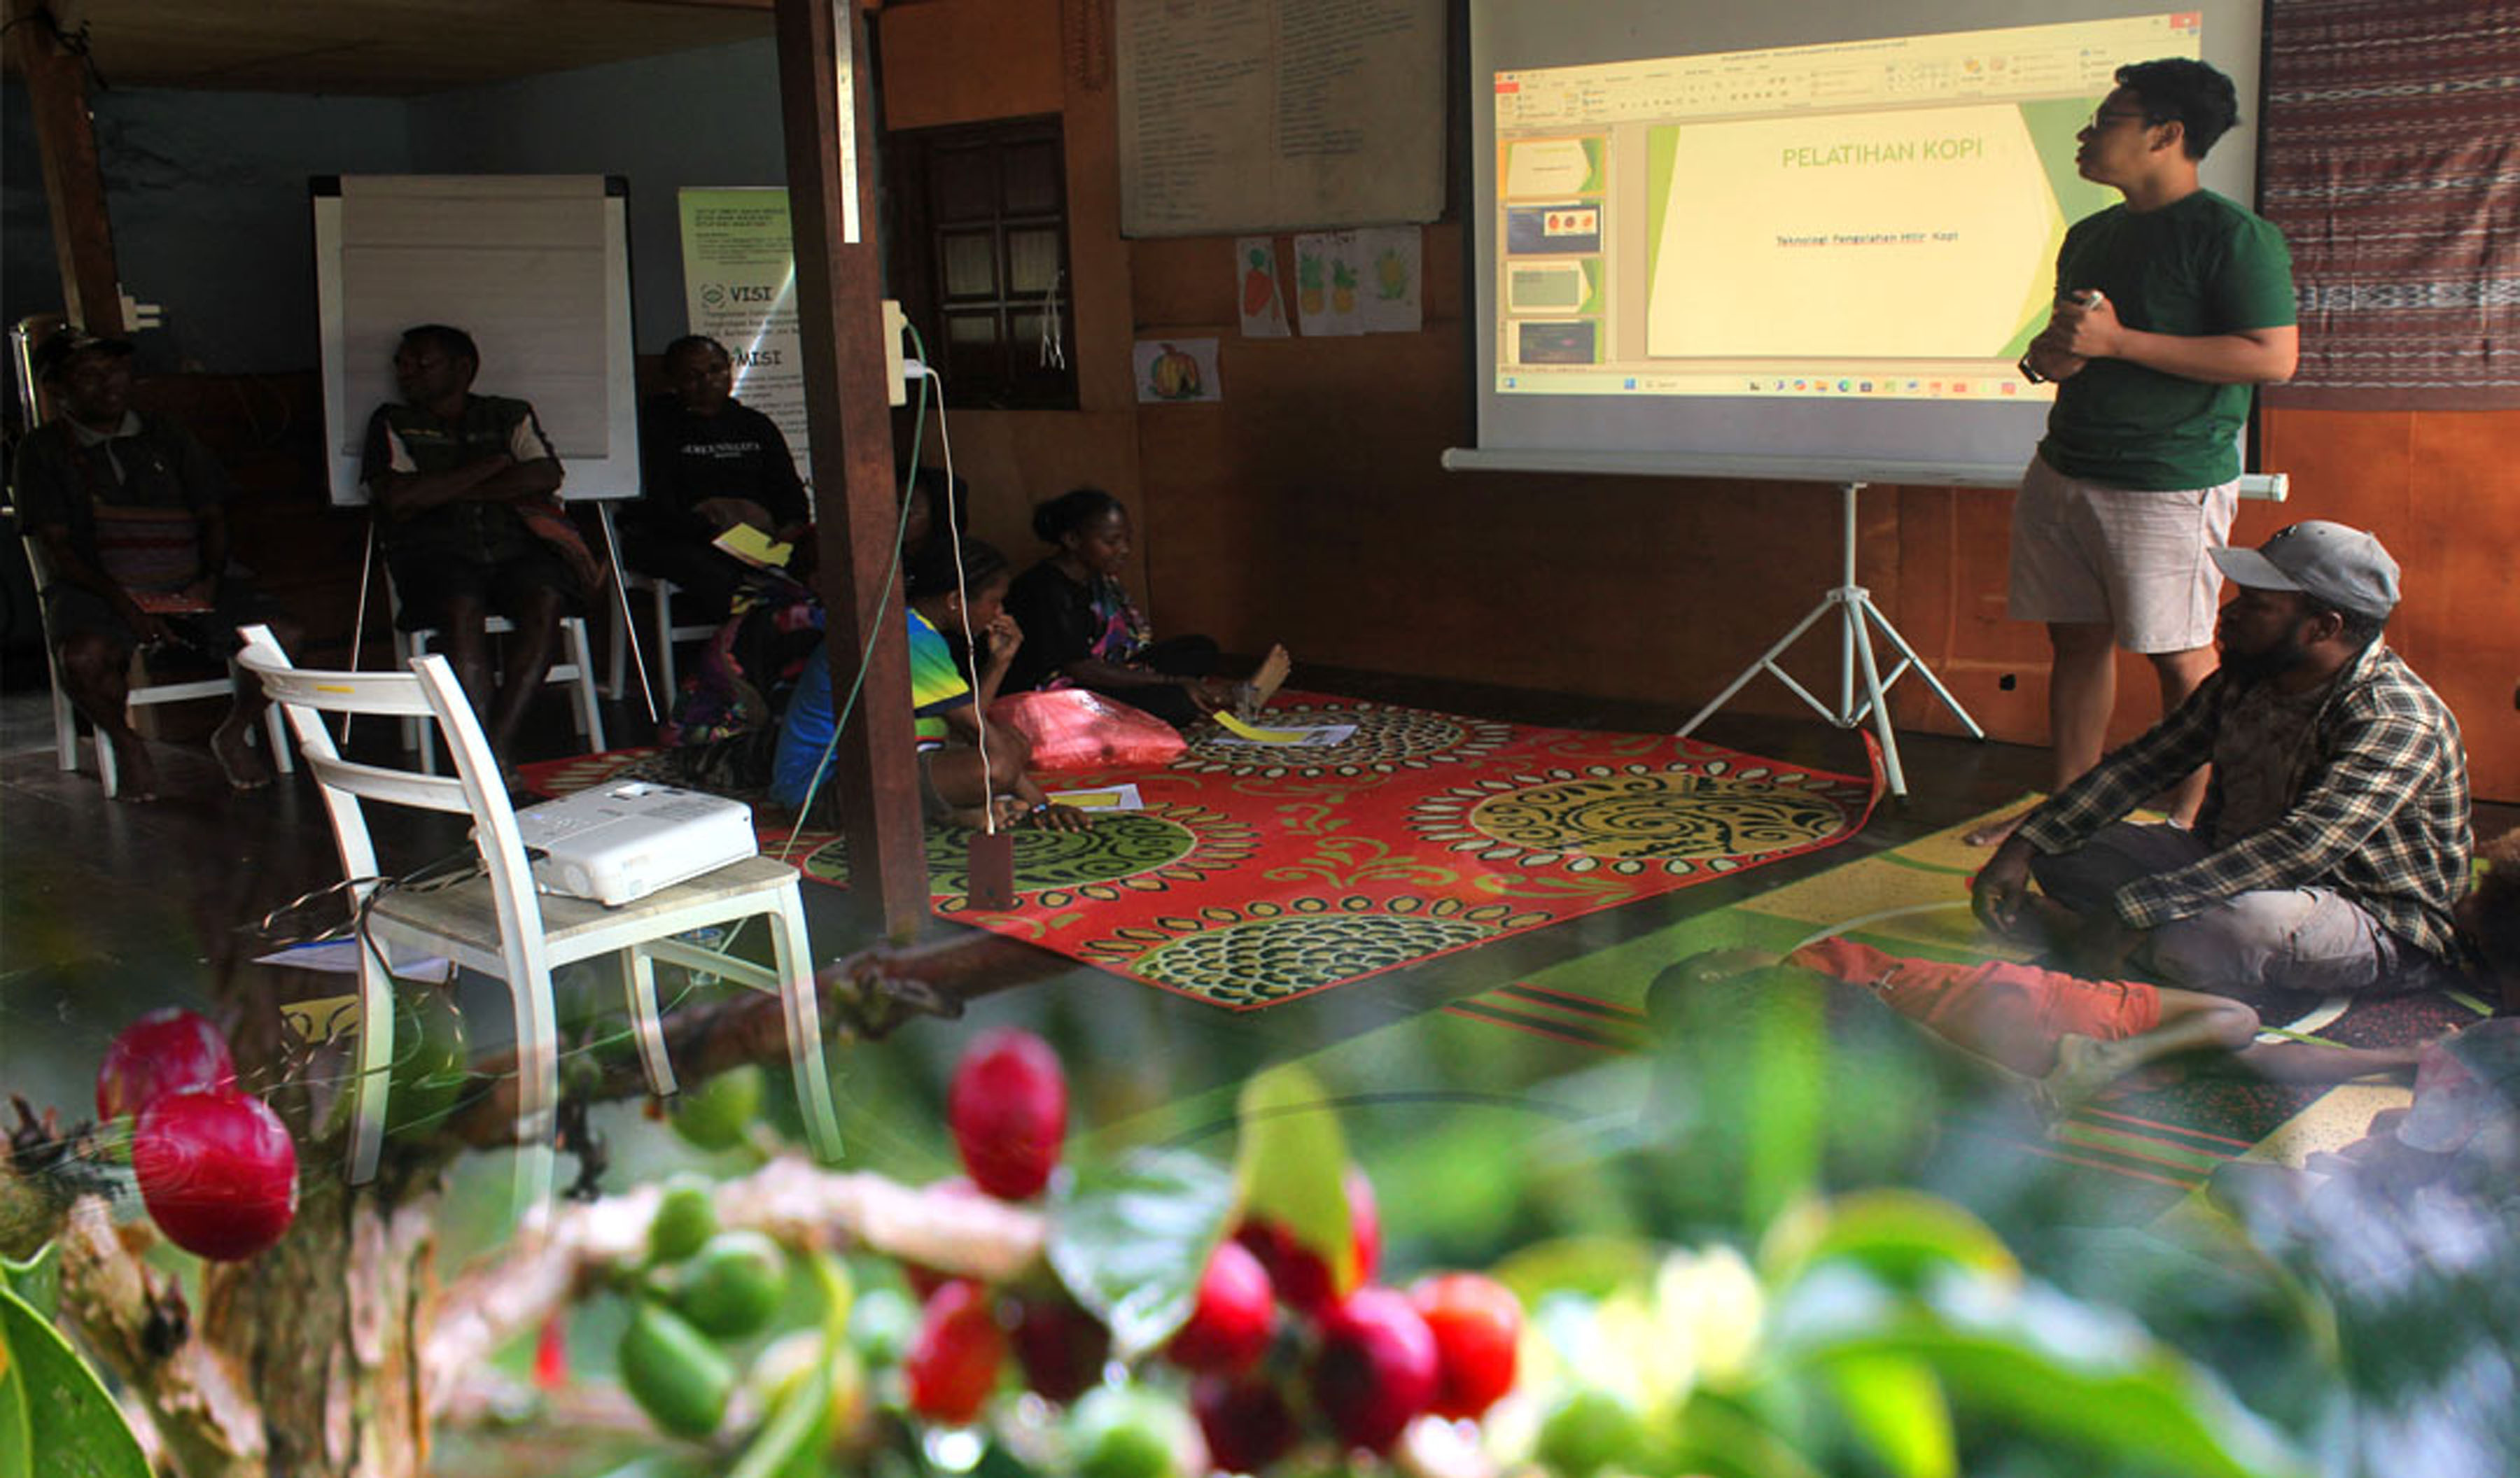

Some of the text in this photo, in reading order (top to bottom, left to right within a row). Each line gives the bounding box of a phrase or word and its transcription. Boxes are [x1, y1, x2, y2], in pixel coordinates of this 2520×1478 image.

[1782, 137, 1982, 167] PELATIHAN KOPI
[730, 286, 773, 302] VISI
[736, 351, 781, 366] MISI
